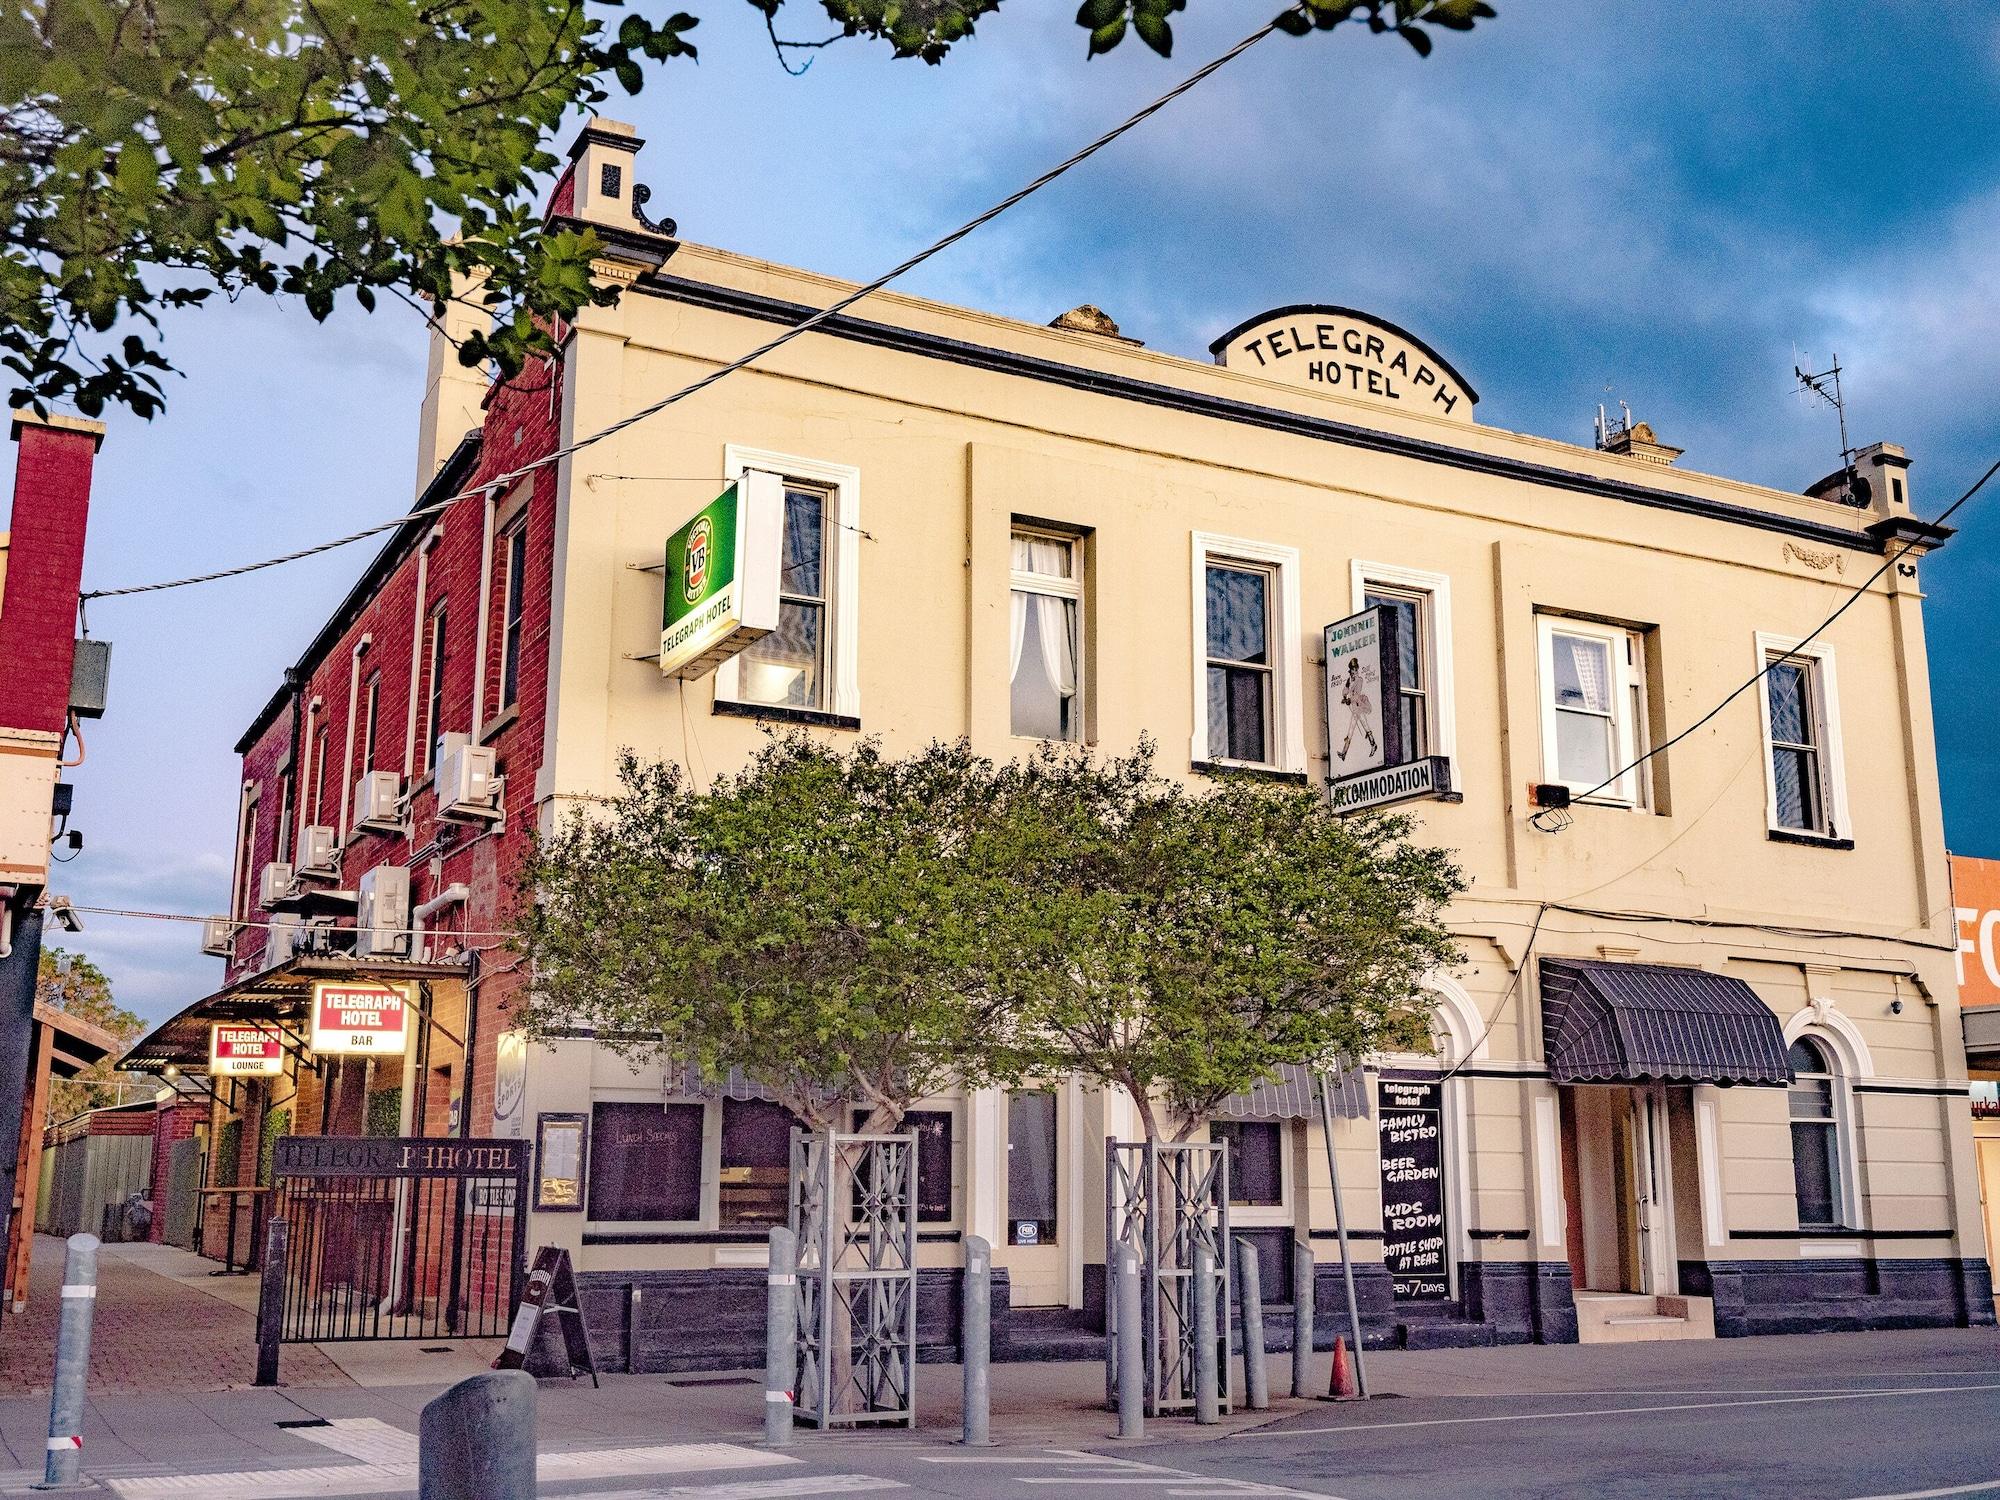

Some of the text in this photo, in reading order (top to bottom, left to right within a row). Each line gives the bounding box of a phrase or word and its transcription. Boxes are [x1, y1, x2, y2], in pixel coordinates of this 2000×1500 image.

[1244, 325, 1458, 414] TELEGRAPH
[1309, 361, 1399, 399] HOTEL
[691, 546, 705, 573] VB
[663, 595, 731, 655] TELEGRAPH HOTEL
[1331, 616, 1375, 643] JOHNNIE
[1331, 633, 1376, 658] WALKER
[325, 993, 401, 1010] TELEGRAPH
[340, 1011, 383, 1026] HOTEL
[220, 1030, 279, 1043] TELEGRAPH
[351, 1035, 373, 1046] BAR
[232, 1043, 265, 1055] HOTEL
[232, 1061, 264, 1070] LOUNGE
[497, 1078, 521, 1109] SPORTS
[1384, 1084, 1430, 1095] telegraph
[1395, 1095, 1420, 1105] hotel
[1380, 1114, 1425, 1132] FAMILY
[1390, 1126, 1437, 1143] BISTRO
[281, 1143, 434, 1169] TELEGRPH
[435, 1146, 517, 1169] HOTEL
[1381, 1157, 1416, 1171] BEER
[1386, 1166, 1439, 1183] GARDEN
[1384, 1201, 1423, 1217] KIDS
[1392, 1214, 1441, 1231] ROOM
[1383, 1236, 1444, 1257] BOTTLE SHOP
[1399, 1251, 1439, 1271] AT REAR
[1393, 1279, 1446, 1297] PEN 7 DAYS
